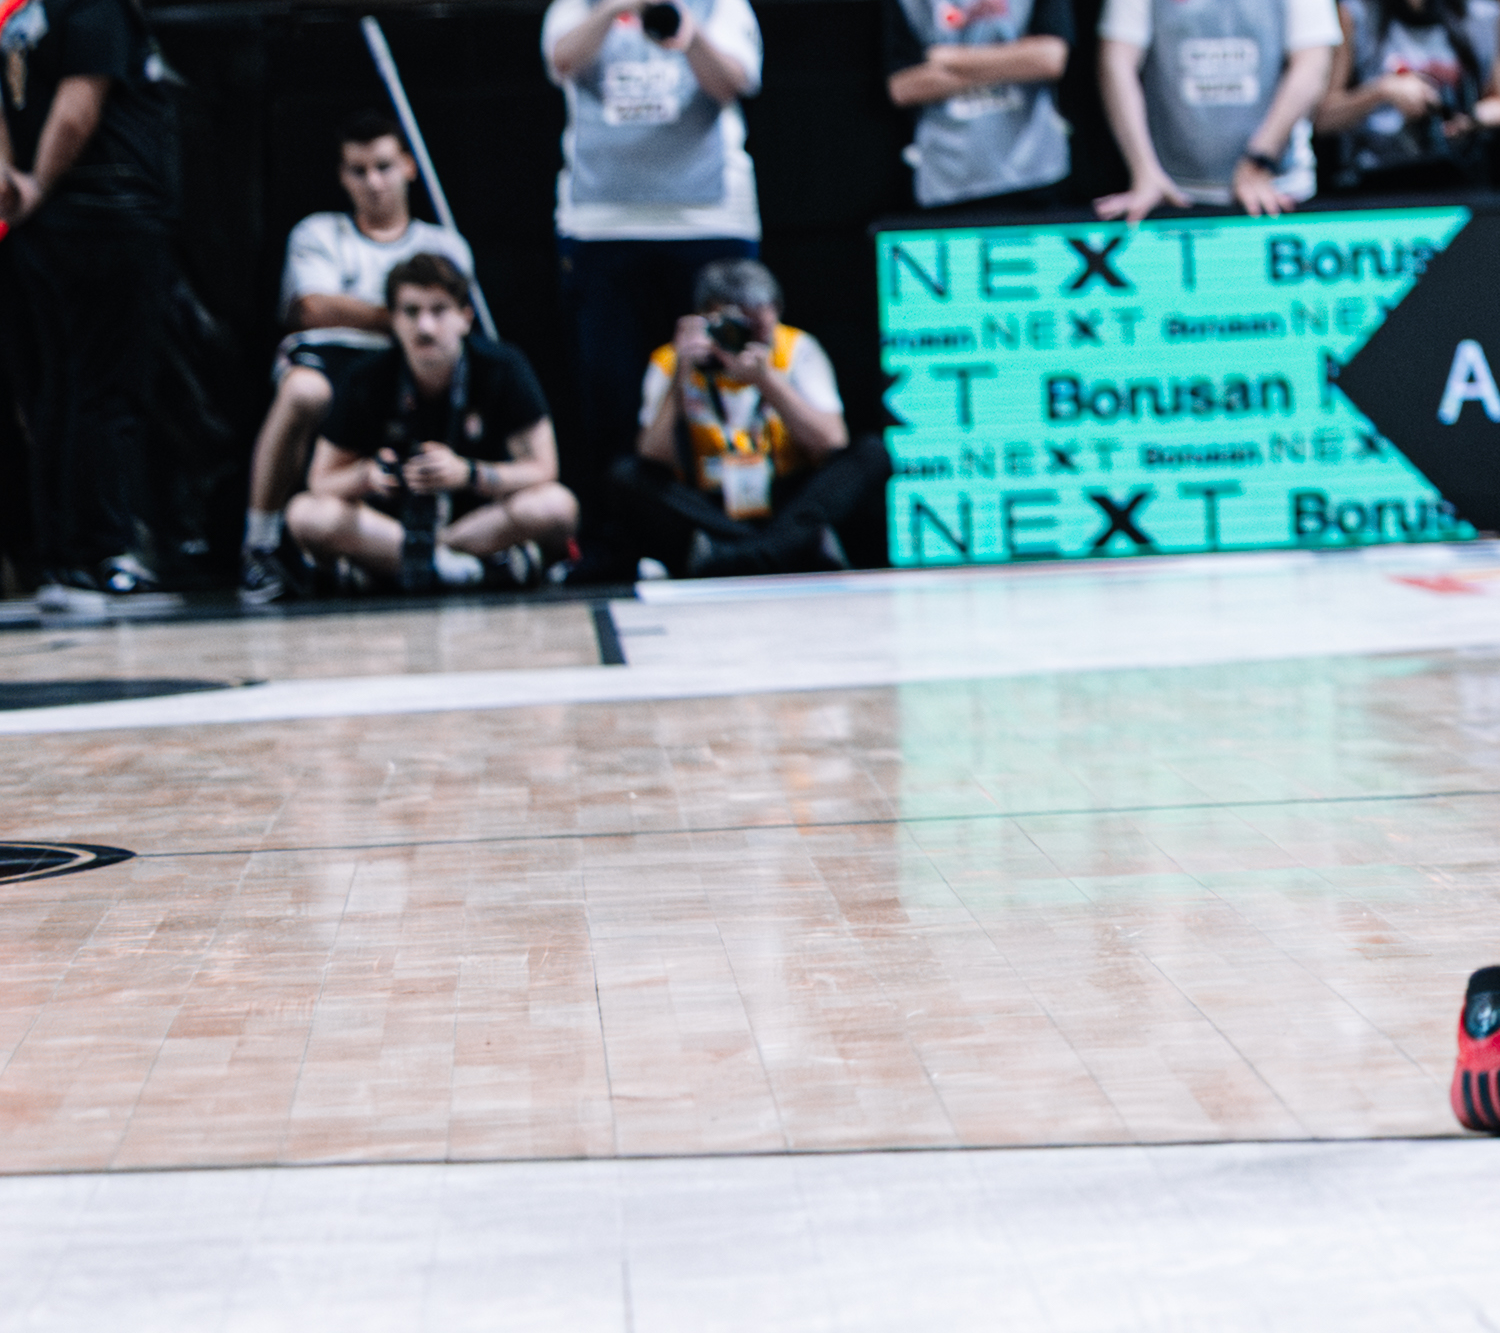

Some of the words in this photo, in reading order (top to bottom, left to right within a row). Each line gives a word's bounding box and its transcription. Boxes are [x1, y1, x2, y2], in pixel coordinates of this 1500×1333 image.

[889, 231, 1222, 301] NEXT
[981, 306, 1143, 350] NEXT
[1291, 296, 1392, 336] NE
[1044, 372, 1296, 425] Borusan
[958, 436, 1122, 478] NEXT
[910, 481, 1246, 557] NEXT
